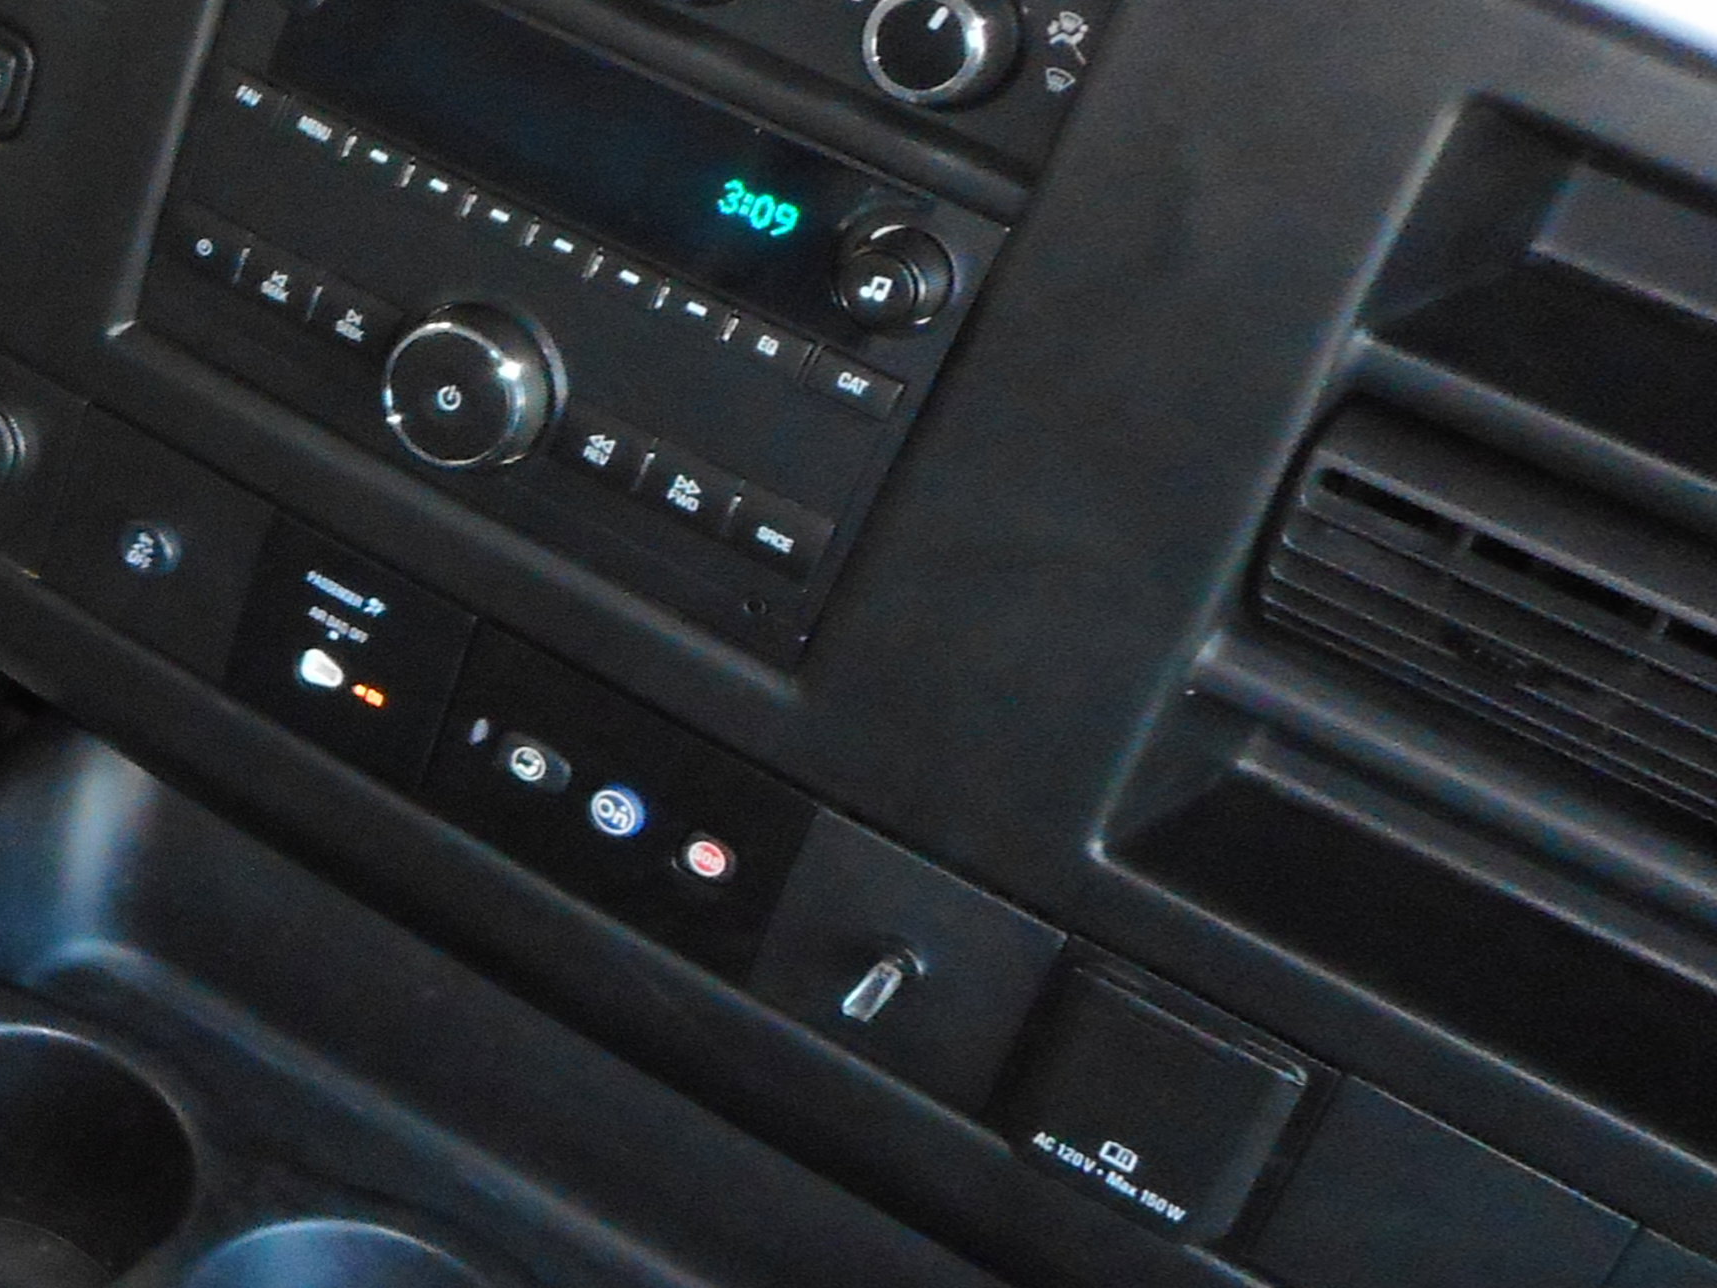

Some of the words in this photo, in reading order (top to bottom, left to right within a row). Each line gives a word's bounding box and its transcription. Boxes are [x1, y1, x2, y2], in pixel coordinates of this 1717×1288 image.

[717, 179, 800, 237] 3:09
[837, 371, 870, 397] CAT
[583, 445, 610, 467] REV
[666, 487, 699, 512] FWD
[756, 525, 795, 555] SRCE
[1032, 1131, 1056, 1152] AC
[1105, 1170, 1138, 1197] Max
